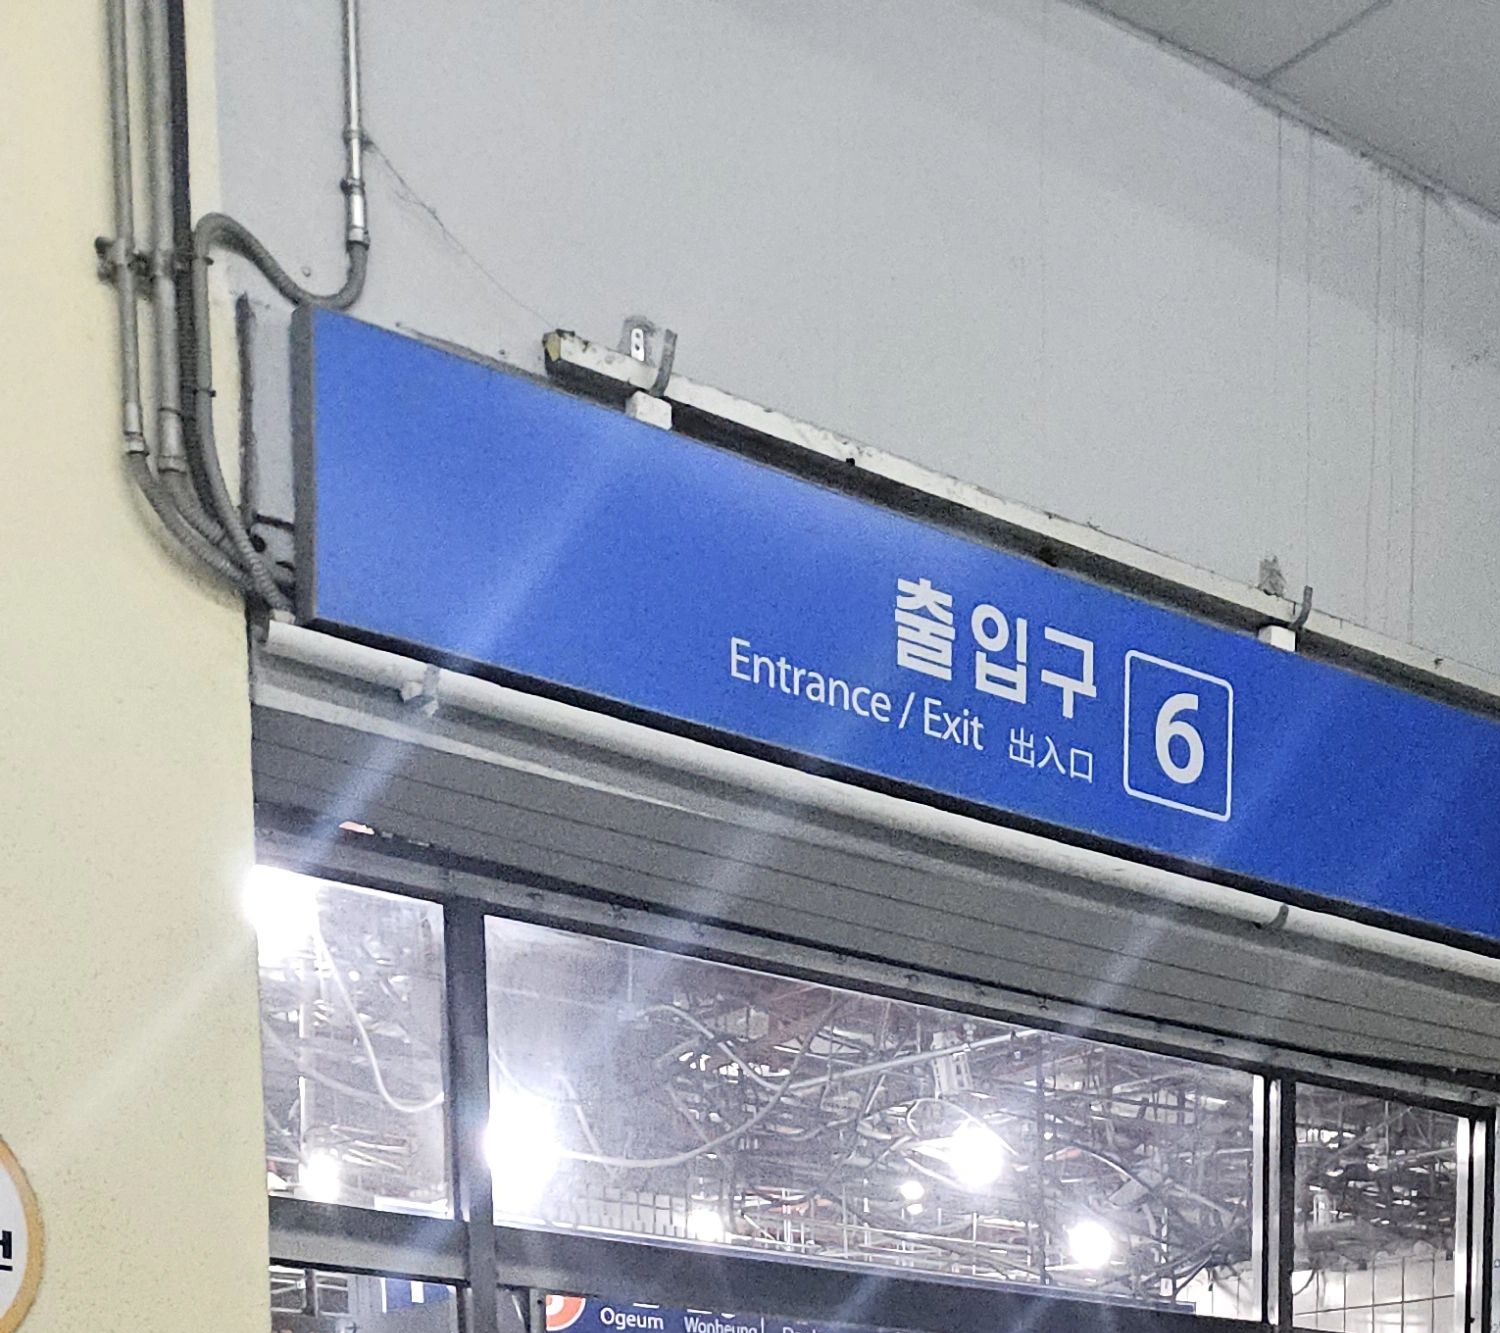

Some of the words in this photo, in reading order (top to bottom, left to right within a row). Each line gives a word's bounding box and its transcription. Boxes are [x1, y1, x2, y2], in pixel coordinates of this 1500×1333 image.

[730, 636, 891, 724] Entrance
[923, 698, 984, 752] Exit
[894, 577, 1098, 719] 출입구
[1154, 692, 1205, 785] 6
[1008, 727, 1094, 784] 出入口
[600, 1306, 664, 1330] Ogeum
